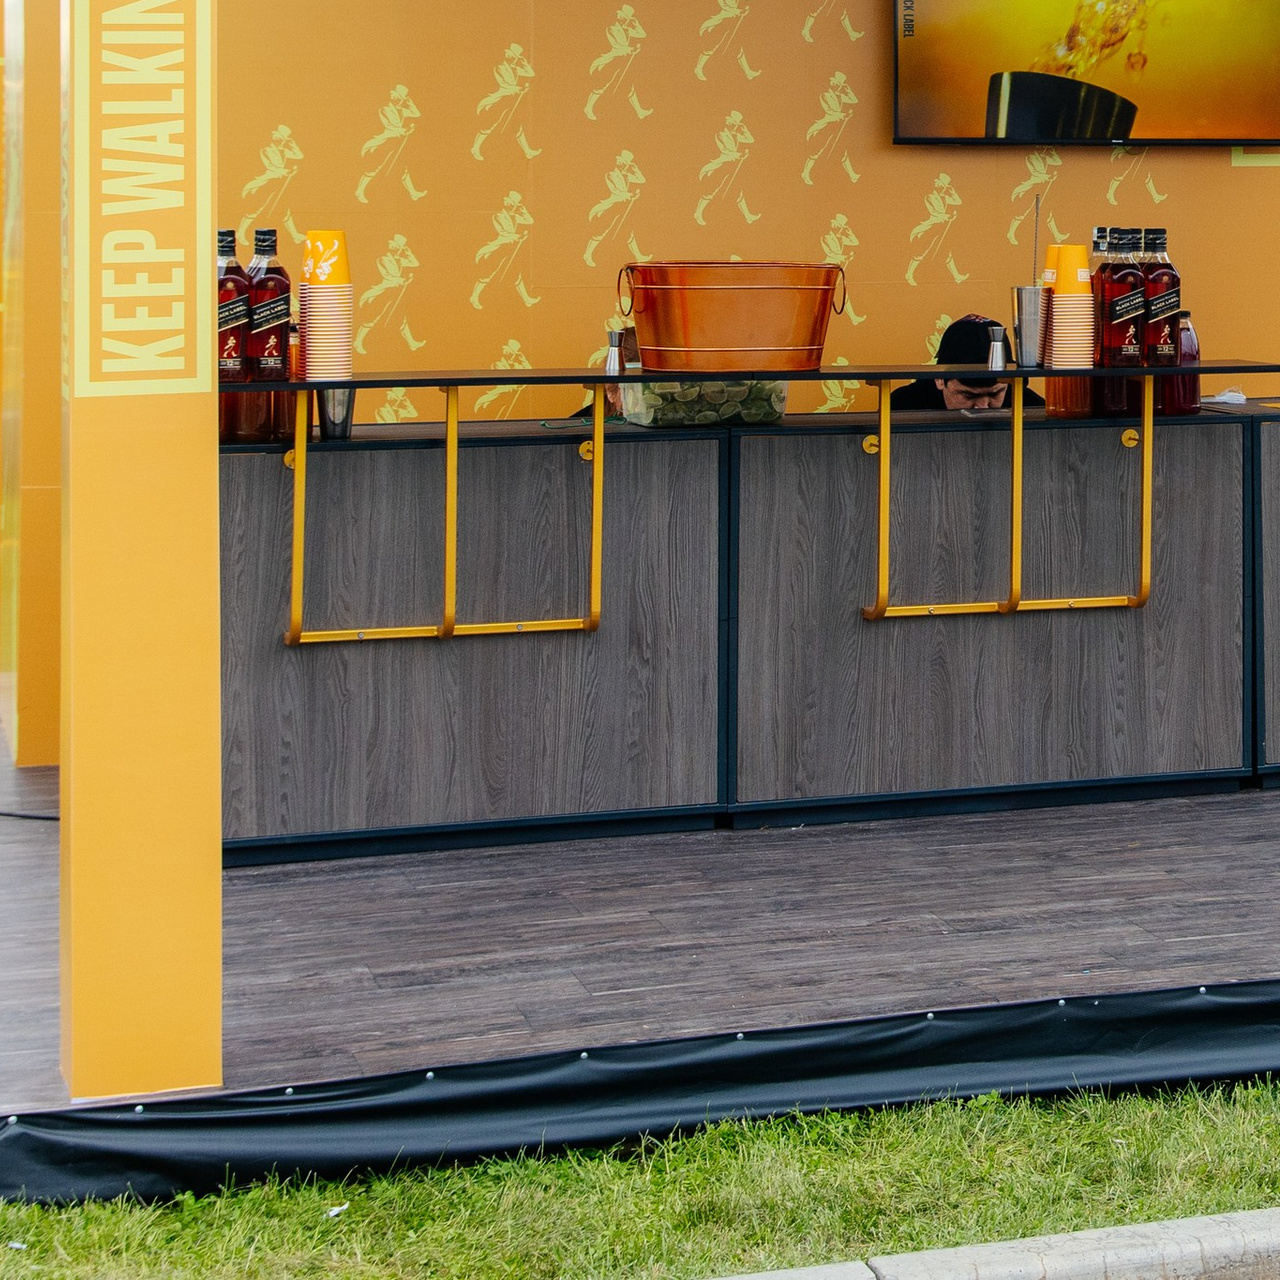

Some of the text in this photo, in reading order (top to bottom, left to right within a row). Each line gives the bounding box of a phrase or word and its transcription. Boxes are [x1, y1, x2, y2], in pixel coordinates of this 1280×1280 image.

[902, 13, 915, 38] LABEL
[100, 228, 187, 375] KEEP
[1115, 302, 1130, 310] BLACK
[1130, 297, 1144, 305] LABEL
[1151, 302, 1165, 310] BLACK
[1165, 296, 1179, 305] LABEL
